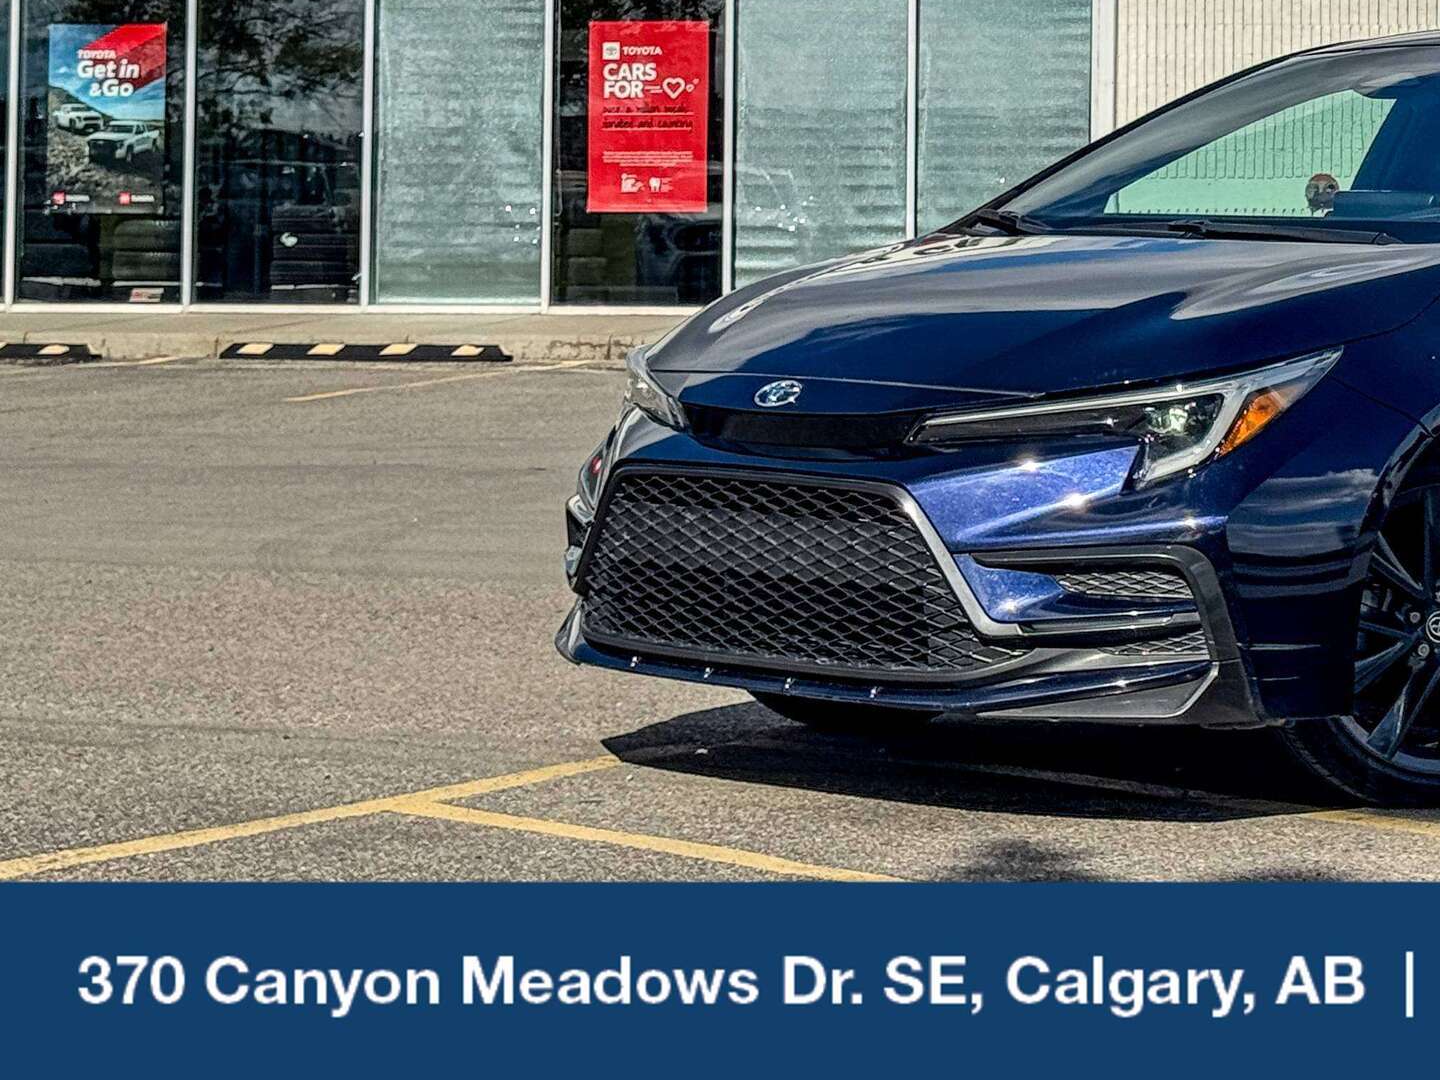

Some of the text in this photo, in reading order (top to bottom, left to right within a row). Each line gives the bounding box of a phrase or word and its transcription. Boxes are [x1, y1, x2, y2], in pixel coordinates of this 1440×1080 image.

[77, 49, 117, 59] TOYOTA
[622, 46, 663, 56] TOYOTA
[77, 58, 140, 79] Get in
[603, 63, 657, 81] CARS
[603, 80, 644, 99] FOR
